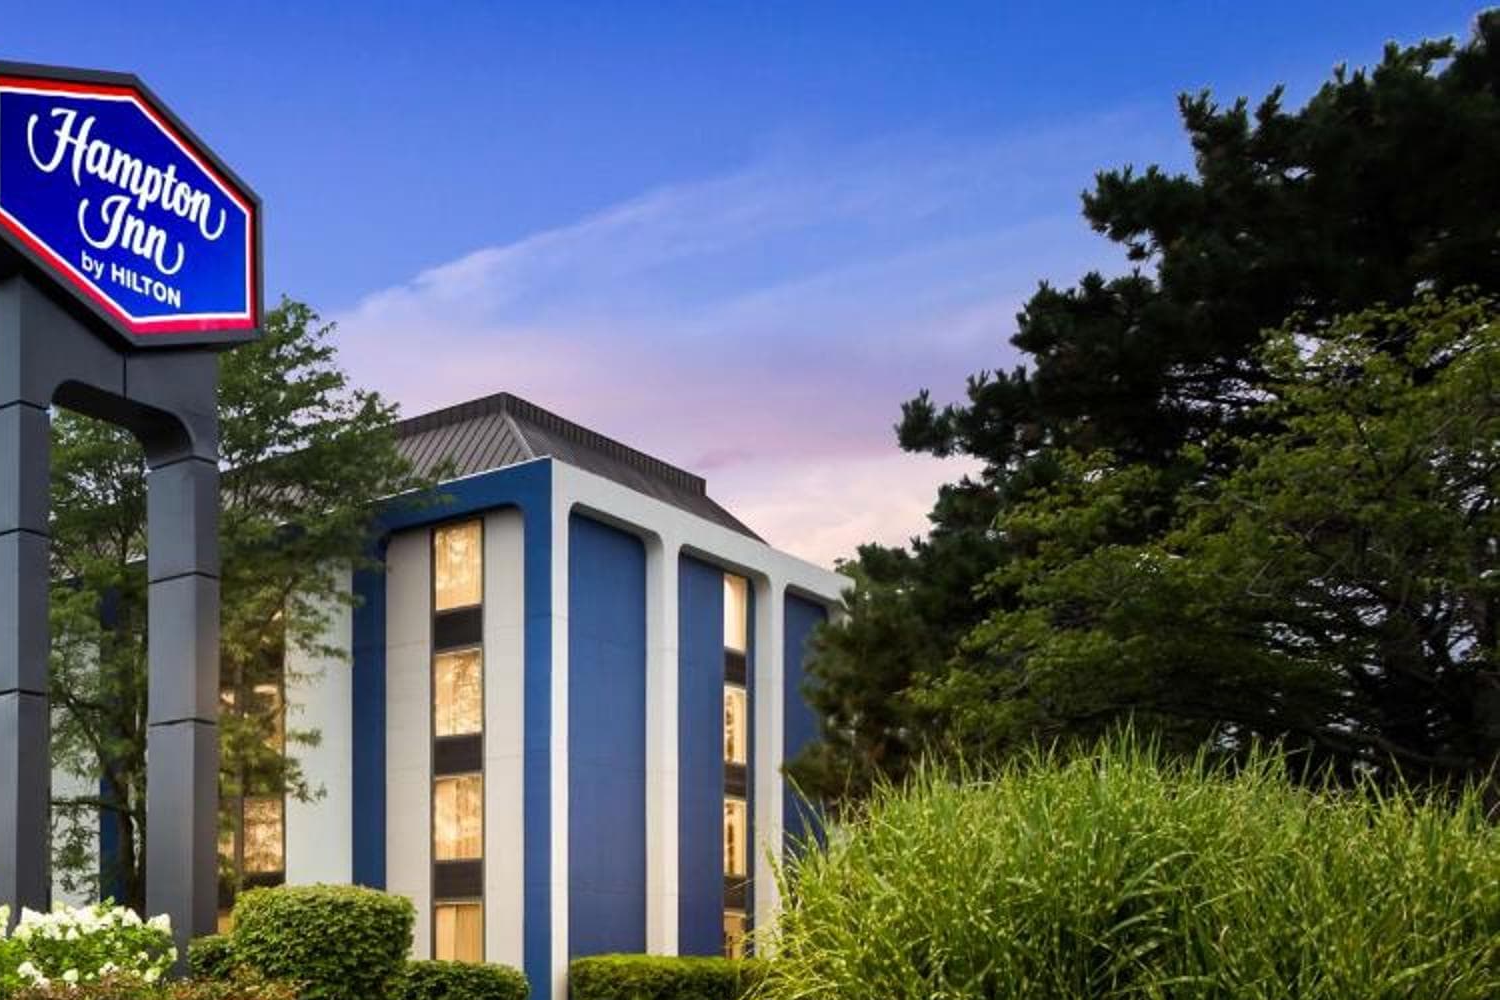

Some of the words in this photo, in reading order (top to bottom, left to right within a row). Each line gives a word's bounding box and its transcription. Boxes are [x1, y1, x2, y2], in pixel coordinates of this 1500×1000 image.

[27, 107, 226, 240] Hampton
[78, 195, 184, 275] Inn
[82, 250, 104, 280] by
[111, 262, 181, 308] HILTON
